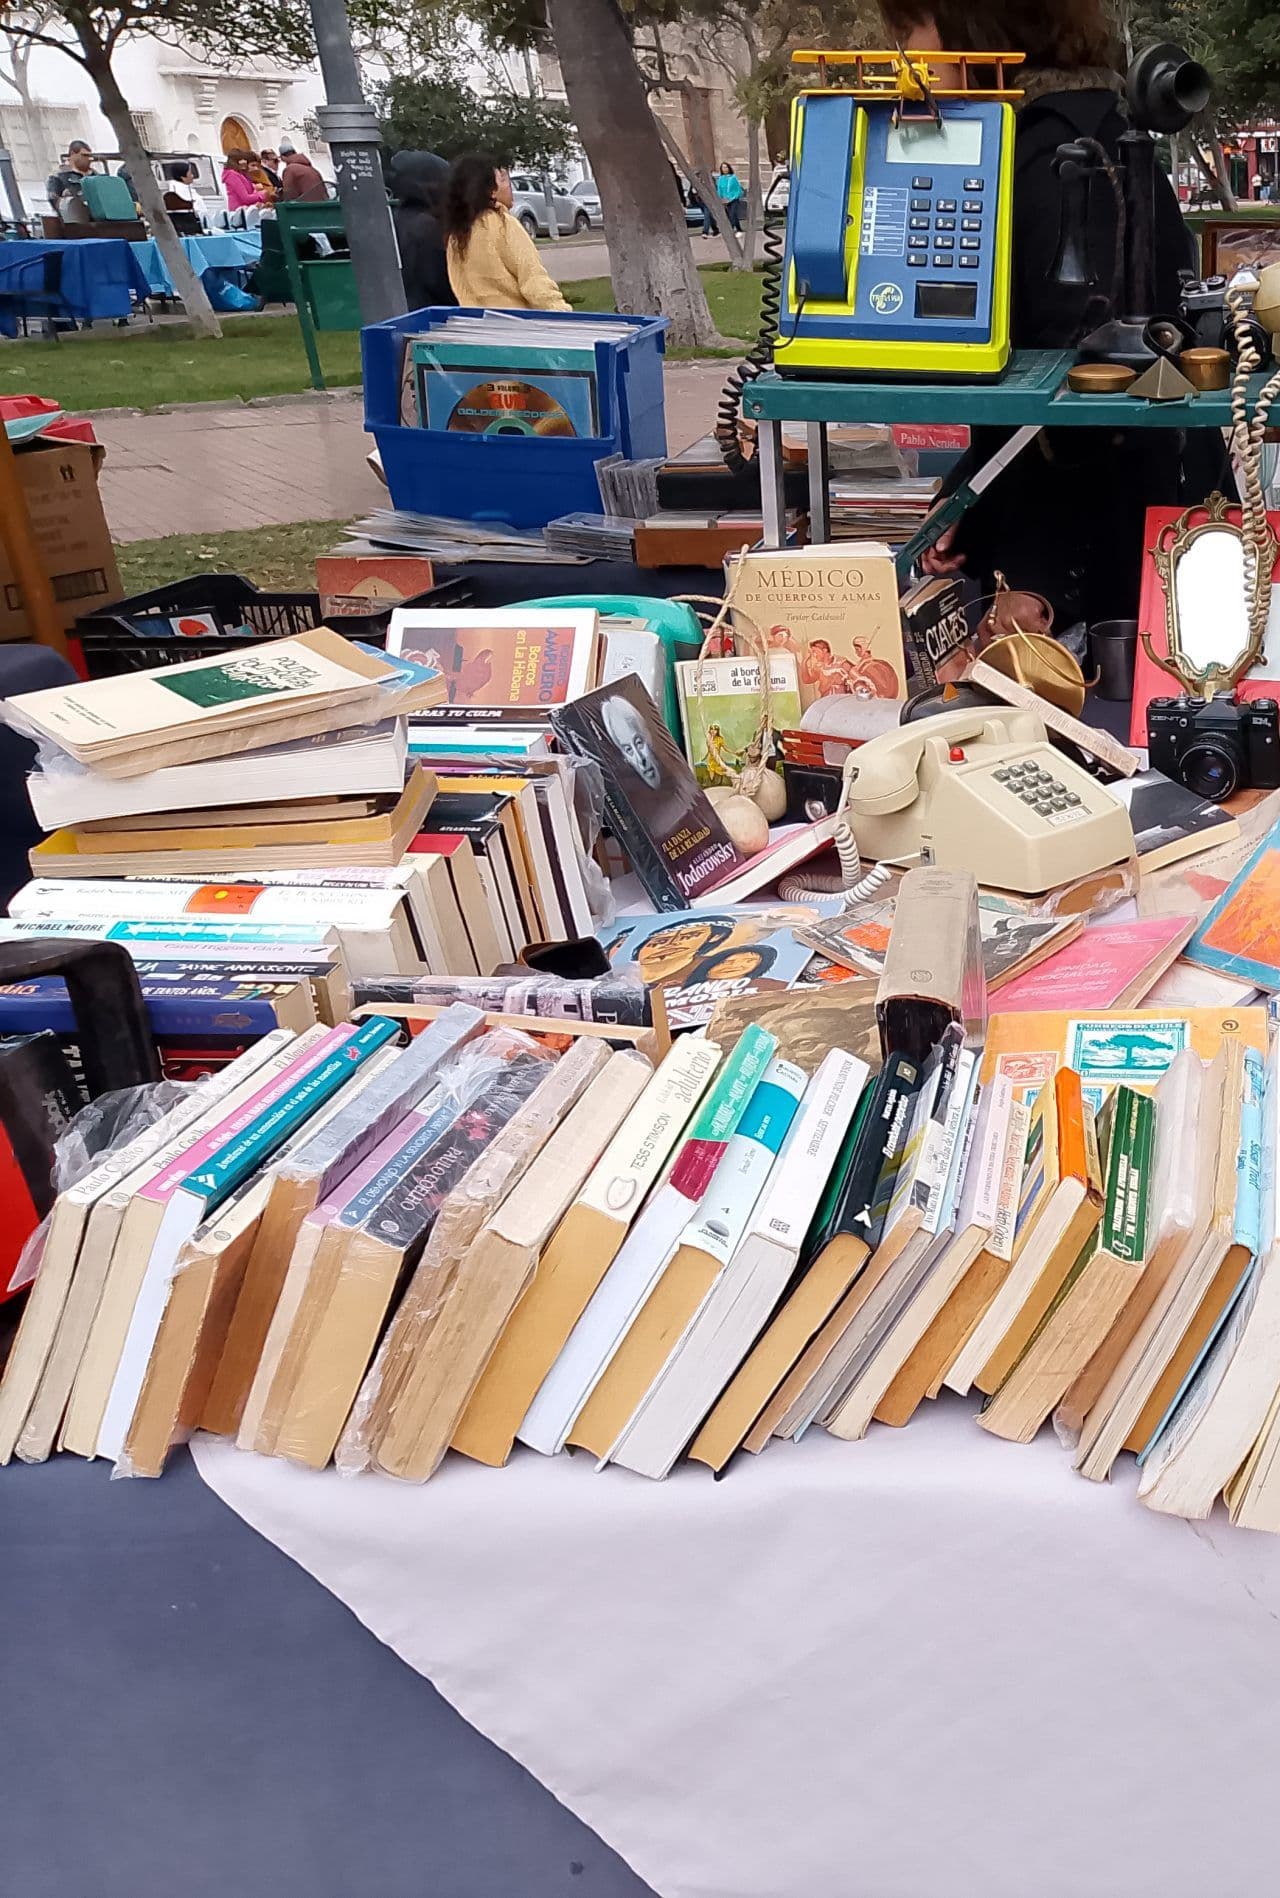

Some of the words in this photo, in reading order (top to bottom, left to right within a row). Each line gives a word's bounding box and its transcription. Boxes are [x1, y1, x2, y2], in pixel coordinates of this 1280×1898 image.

[900, 432, 926, 446] Pablo
[757, 565, 863, 588] MÉDICO
[746, 594, 762, 602] DE
[768, 593, 823, 602] CUERPOS
[829, 593, 836, 601] Y
[841, 592, 881, 601] ALMAS
[515, 630, 526, 643] en
[926, 607, 968, 660] CLAVES
[525, 645, 542, 686] Boleros
[731, 668, 738, 677] al
[740, 666, 760, 677] bord
[509, 661, 524, 702] Habana
[732, 678, 742, 687] de
[744, 677, 752, 686] la
[447, 710, 462, 718] TU
[671, 828, 693, 844] DANZA
[677, 842, 737, 896] Jodorowsky
[13, 923, 62, 931] MICHAEL
[64, 924, 104, 932] MOORE
[176, 962, 223, 972] JAYNE
[225, 964, 254, 973] ANN
[273, 1058, 287, 1070] El
[676, 1051, 712, 1104] adulterio
[629, 1147, 651, 1171] TESS
[644, 1112, 672, 1151] STIMSON
[880, 1147, 895, 1159] El
[1249, 1140, 1261, 1166] Susan
[434, 1145, 466, 1177] PAULO
[359, 1193, 371, 1206] EL
[368, 1166, 400, 1202] DEMONIO
[402, 1152, 413, 1167] LA
[1248, 1162, 1261, 1190] Trott
[399, 1172, 437, 1213] COELHO
